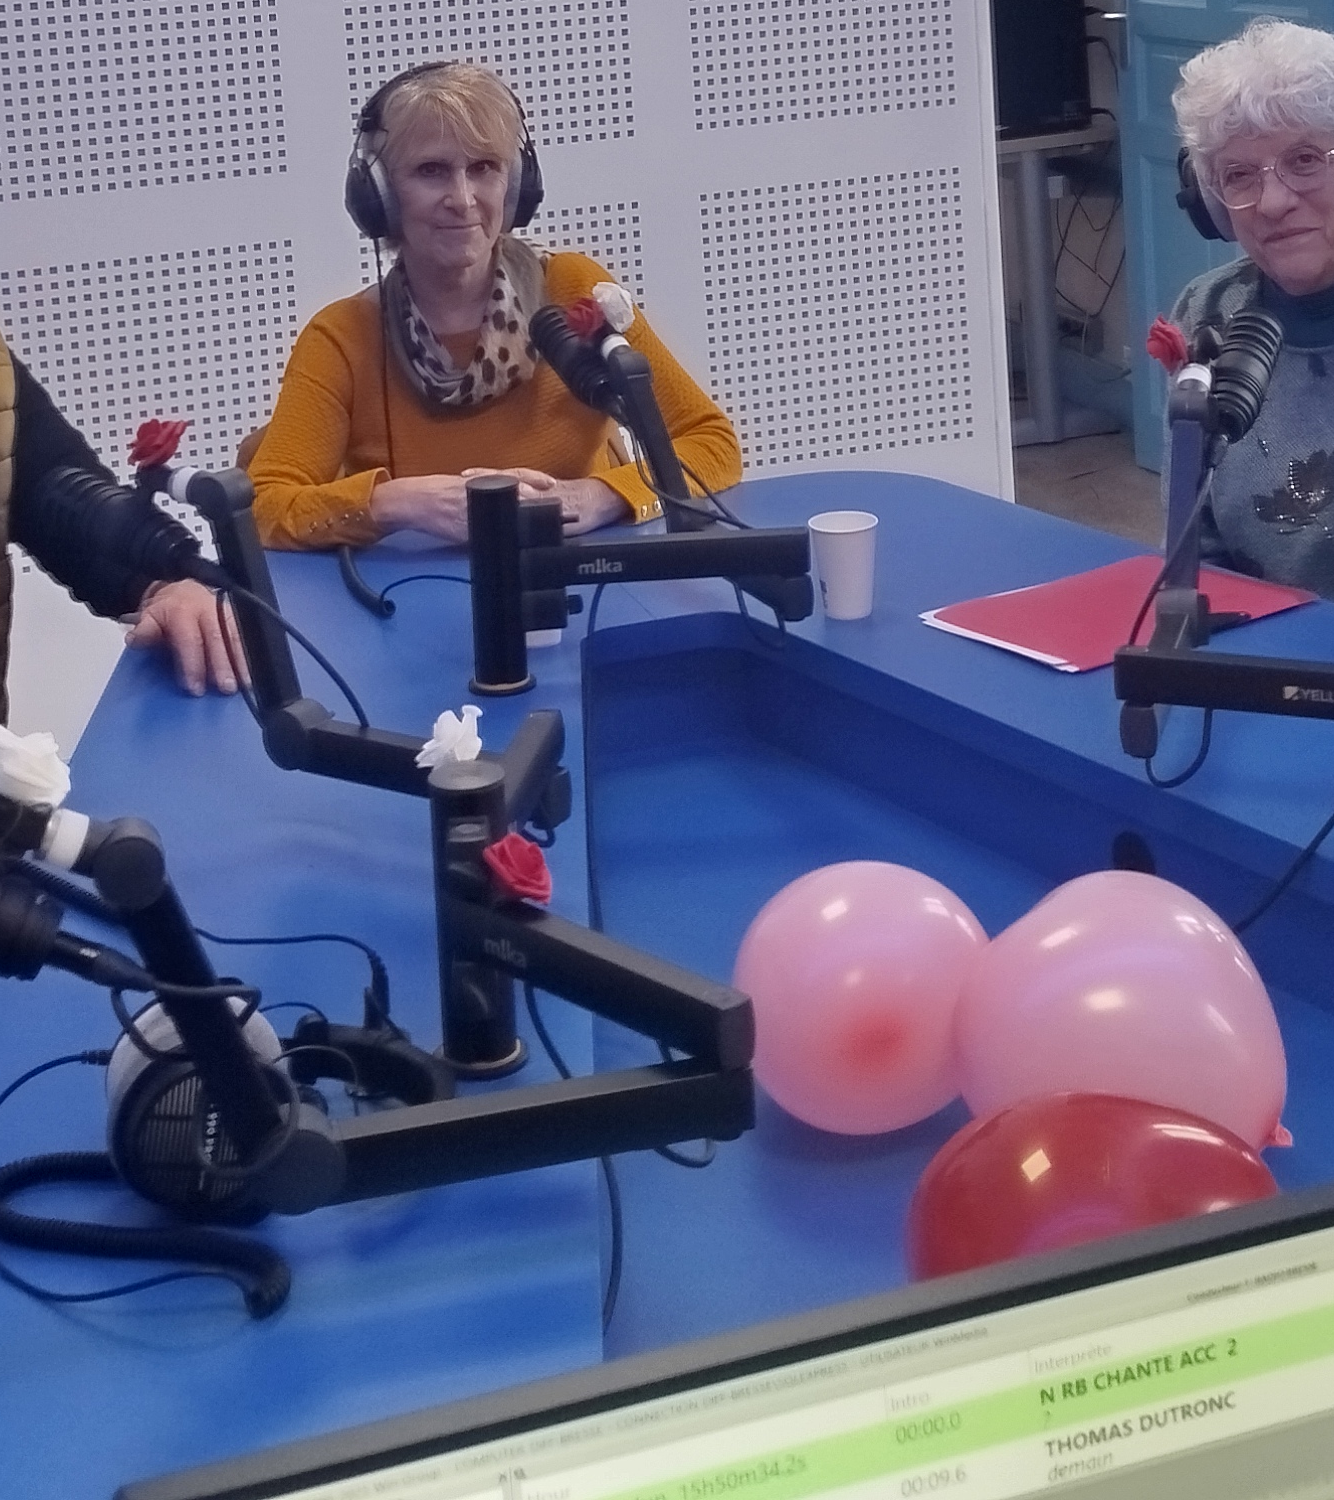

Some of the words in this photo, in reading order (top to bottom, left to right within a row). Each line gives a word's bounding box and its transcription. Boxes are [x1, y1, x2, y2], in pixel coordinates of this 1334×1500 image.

[1039, 1386, 1056, 1406] N
[1061, 1377, 1089, 1400] RB
[1093, 1353, 1175, 1392] CHANTE
[1179, 1342, 1217, 1370] ACC
[1226, 1336, 1238, 1358] 2
[1044, 1419, 1134, 1458] THOMAS
[1138, 1390, 1237, 1434] DUTRONC
[1047, 1451, 1114, 1483] demain
